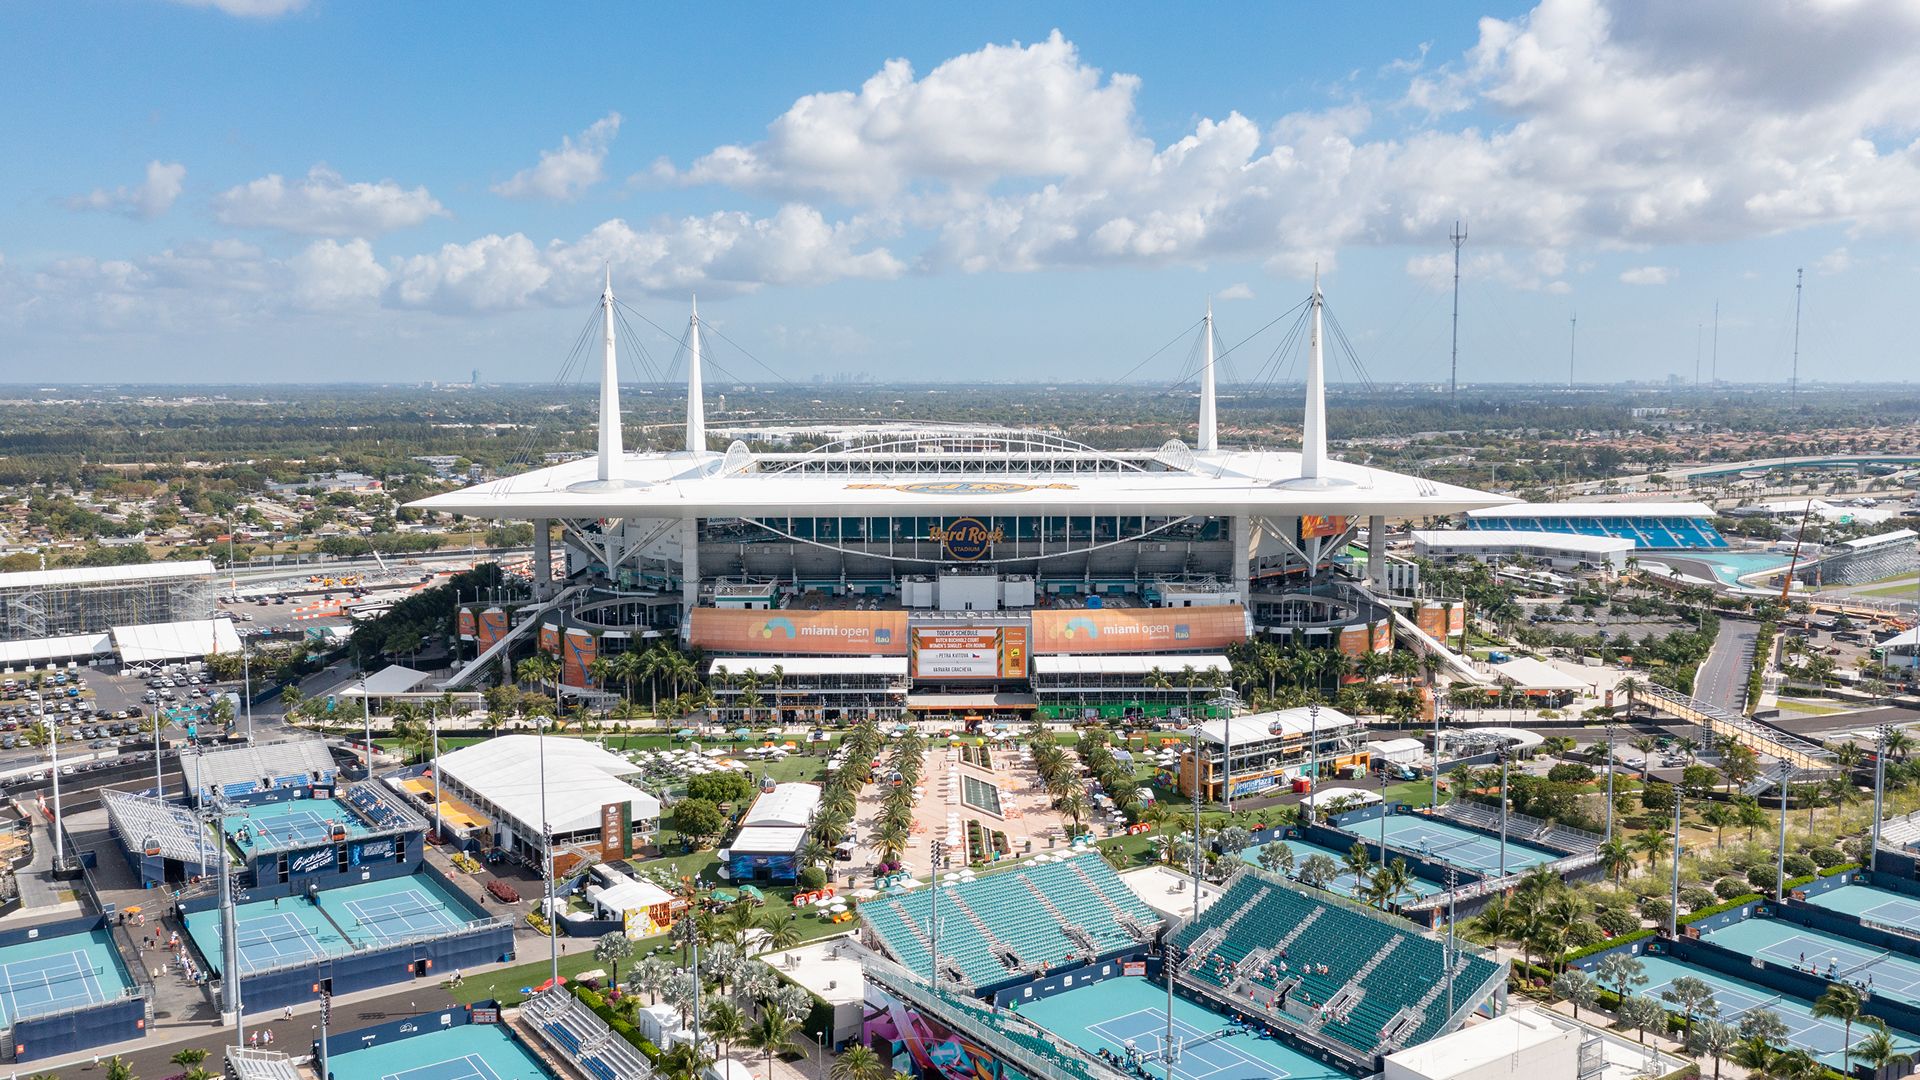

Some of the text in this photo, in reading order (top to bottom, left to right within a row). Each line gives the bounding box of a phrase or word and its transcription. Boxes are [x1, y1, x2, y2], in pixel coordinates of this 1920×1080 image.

[929, 526, 1004, 544] Hard Rock
[801, 625, 870, 639] miami open
[1103, 623, 1170, 637] miami open
